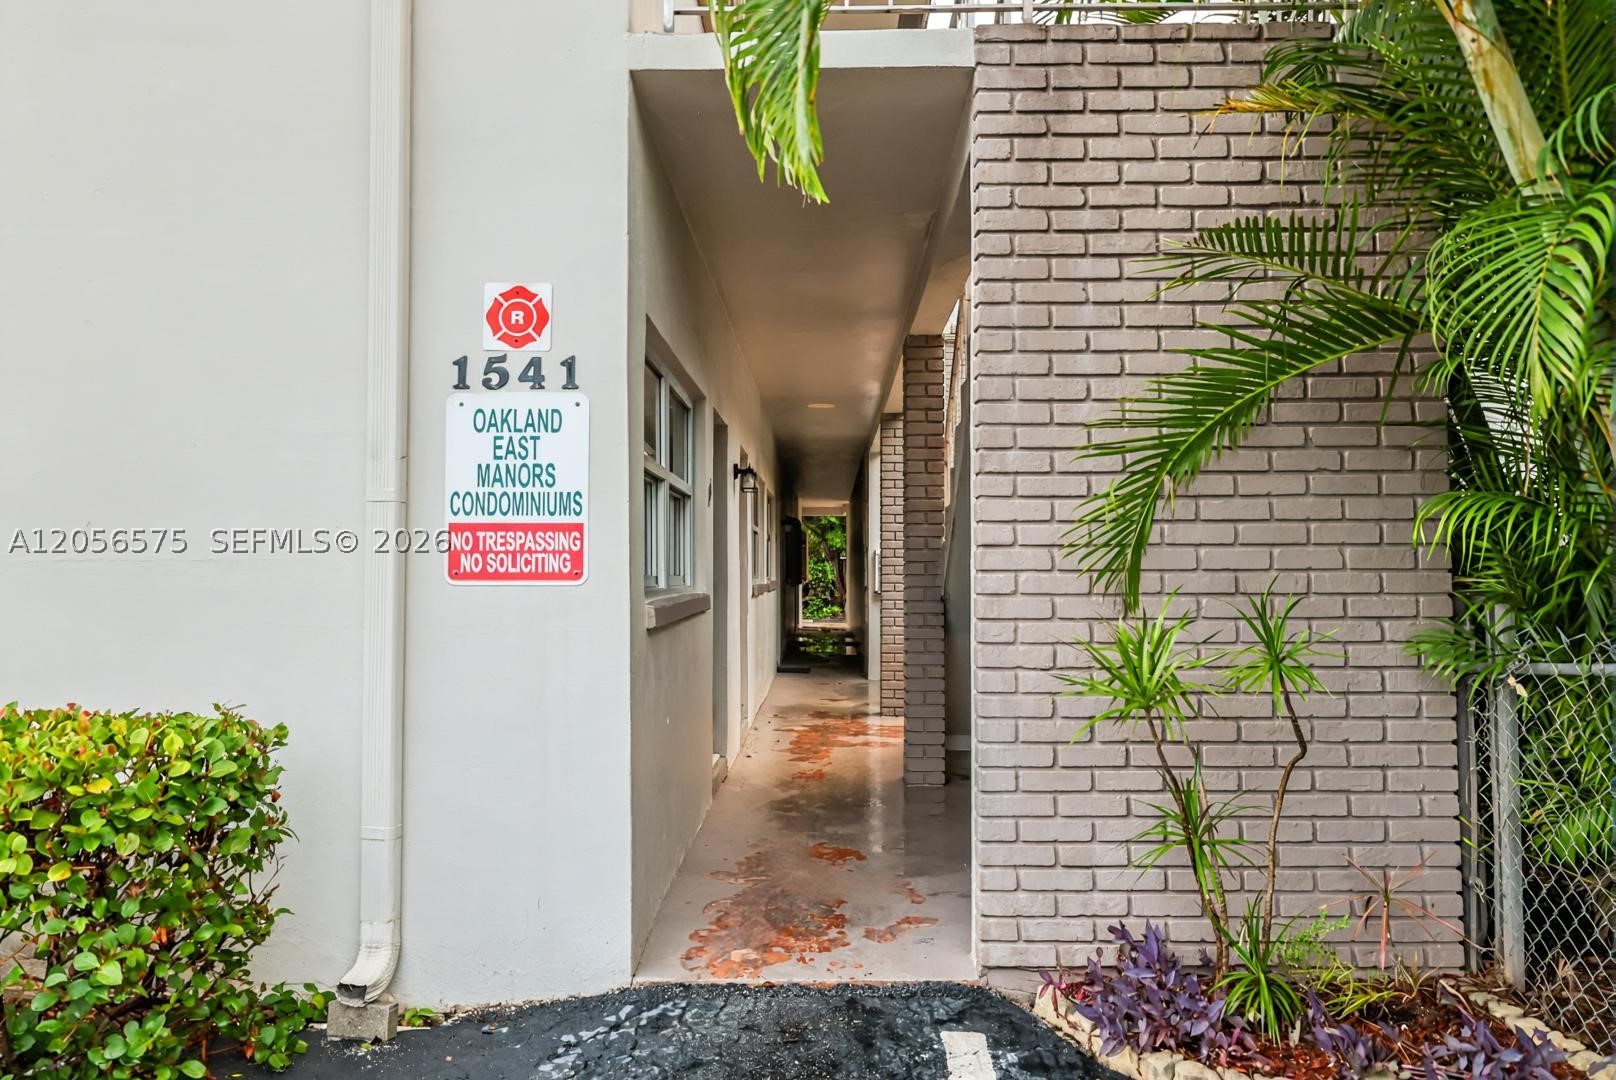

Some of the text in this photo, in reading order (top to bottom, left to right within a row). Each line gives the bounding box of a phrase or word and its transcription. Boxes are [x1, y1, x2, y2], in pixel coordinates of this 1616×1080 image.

[510, 310, 525, 325] R
[452, 354, 579, 390] 1541
[473, 408, 563, 433] OAKLAND
[493, 436, 541, 460] EAST
[477, 463, 556, 488] MANORS
[450, 491, 583, 517] CONDOMINIUMS
[450, 531, 581, 551] NO TRESPASSING
[460, 553, 571, 573] NO SOLICITING
